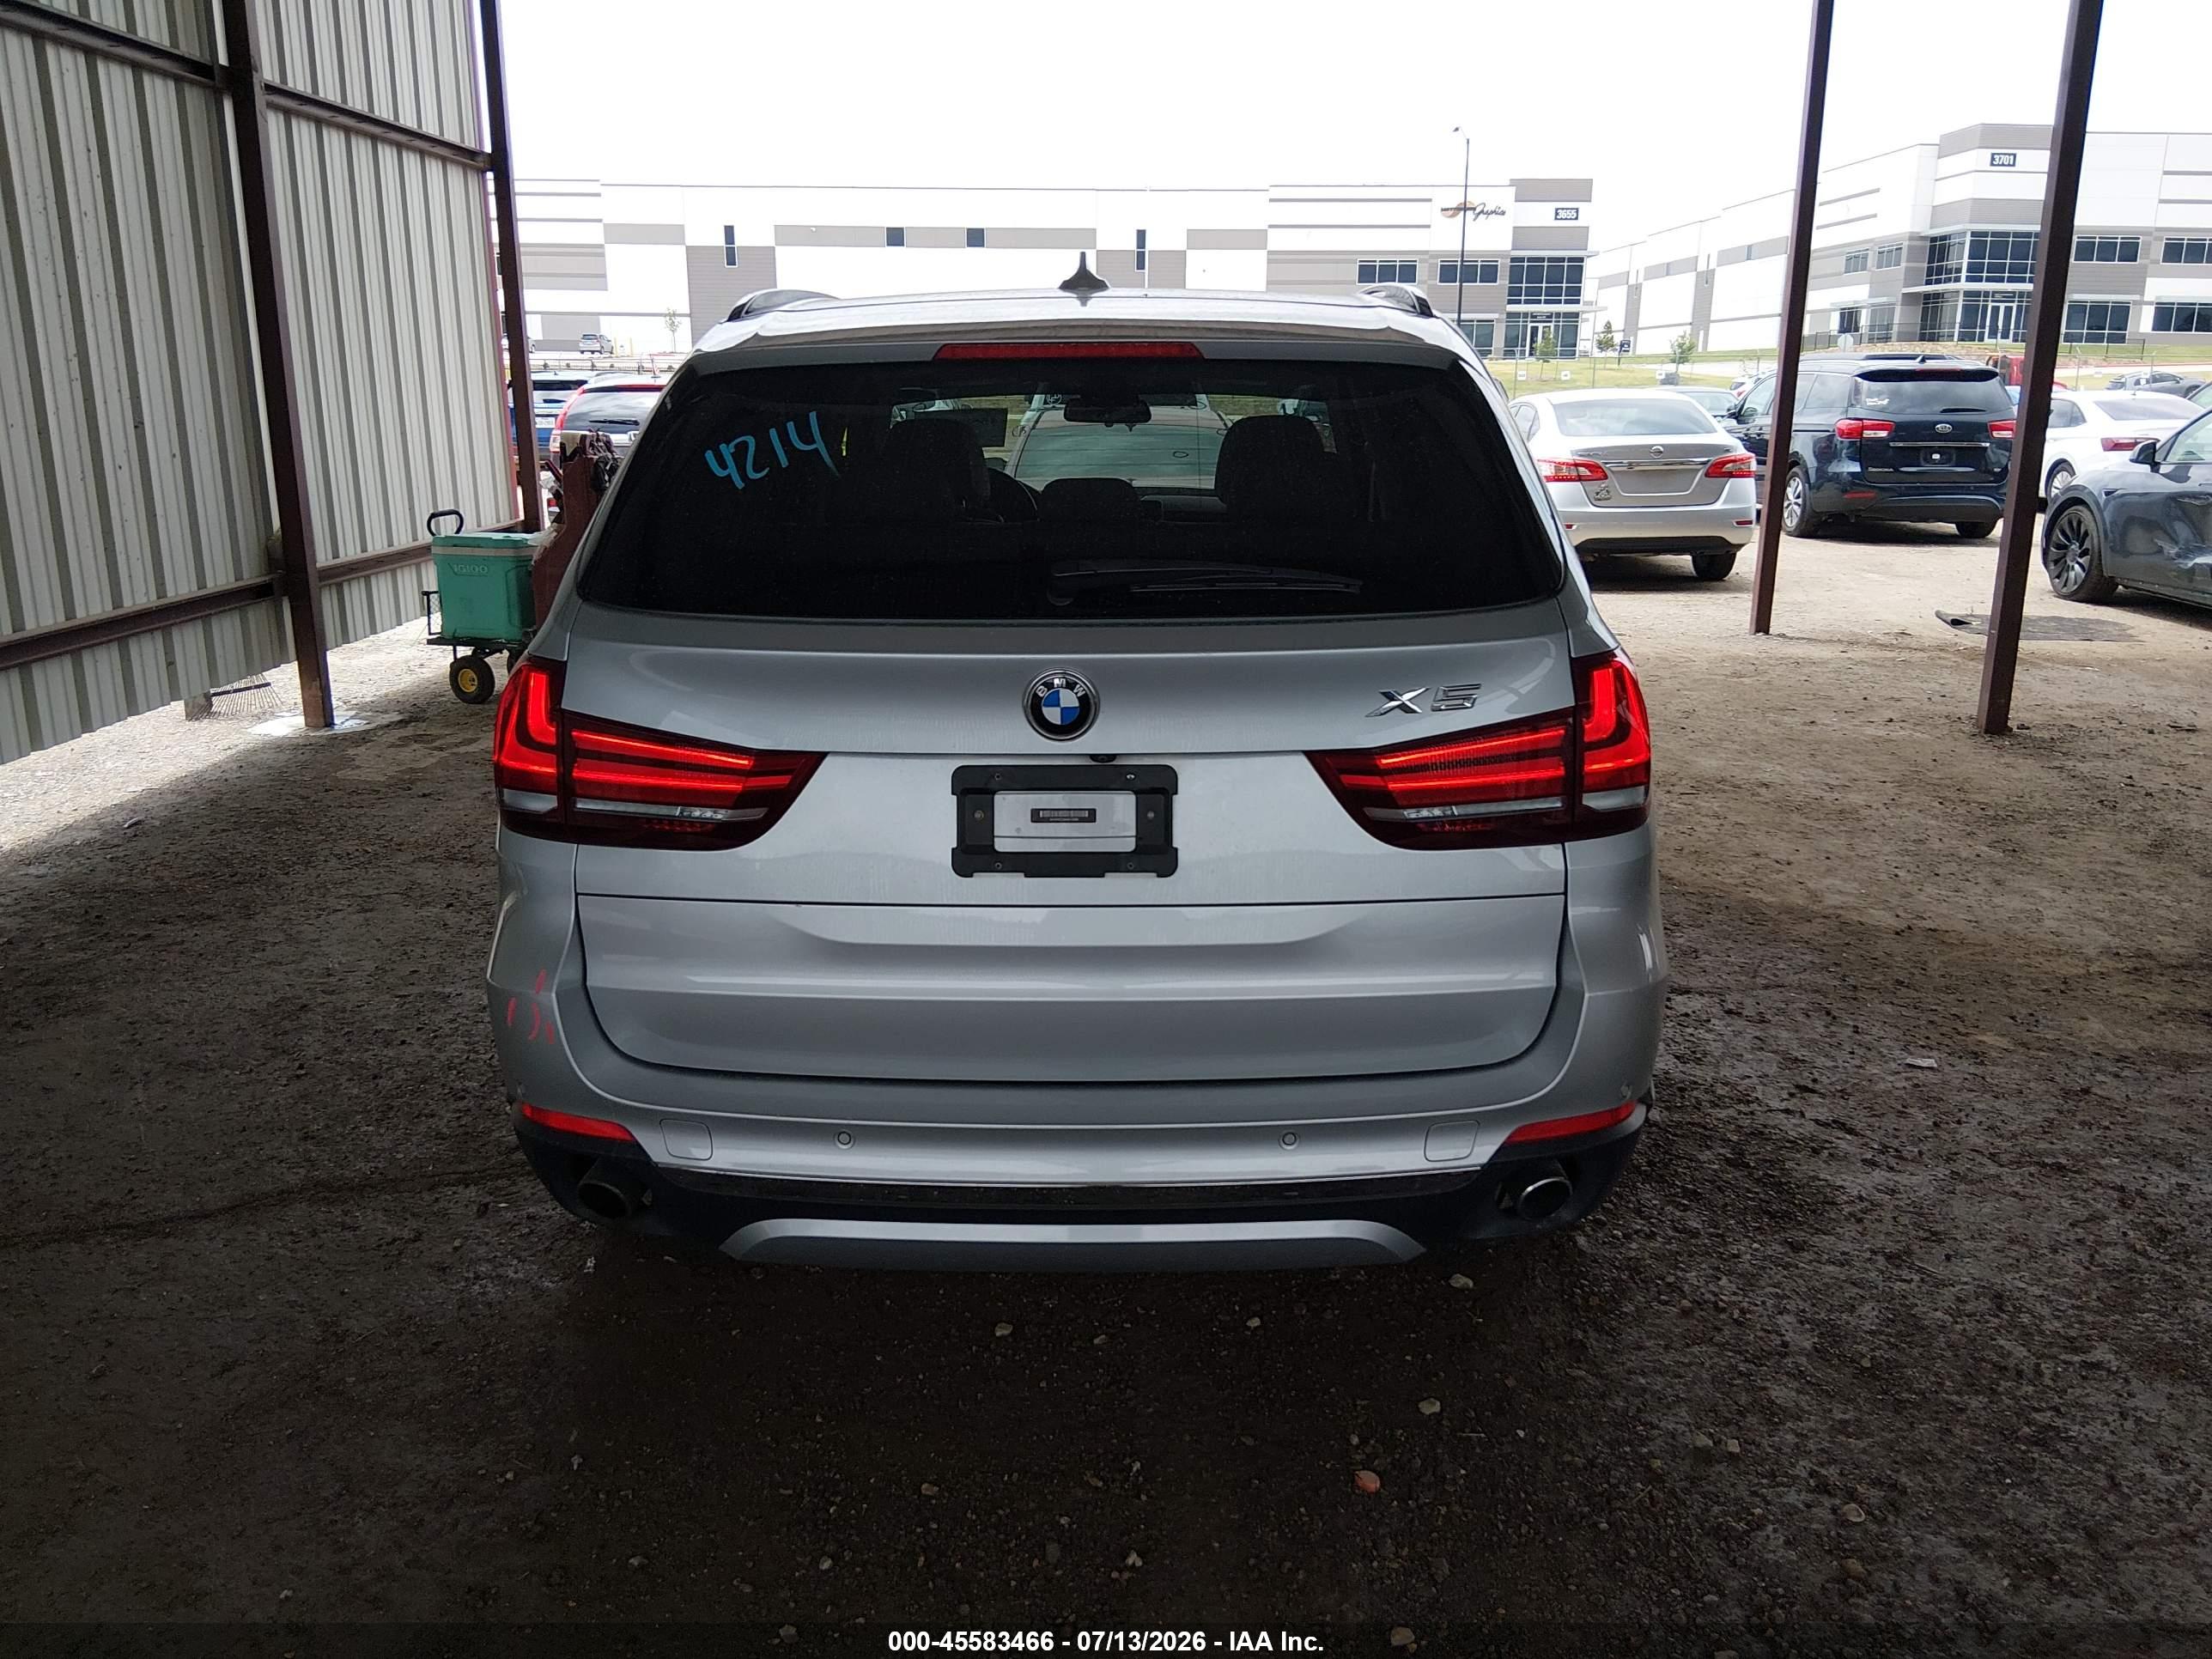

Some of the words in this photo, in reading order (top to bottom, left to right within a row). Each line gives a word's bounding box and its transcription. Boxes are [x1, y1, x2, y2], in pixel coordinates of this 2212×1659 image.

[1992, 155, 2014, 166] 3701
[1556, 209, 1577, 219] 3655
[703, 410, 840, 490] 4214
[1035, 678, 1086, 698] BMW
[1364, 683, 1482, 717] X5
